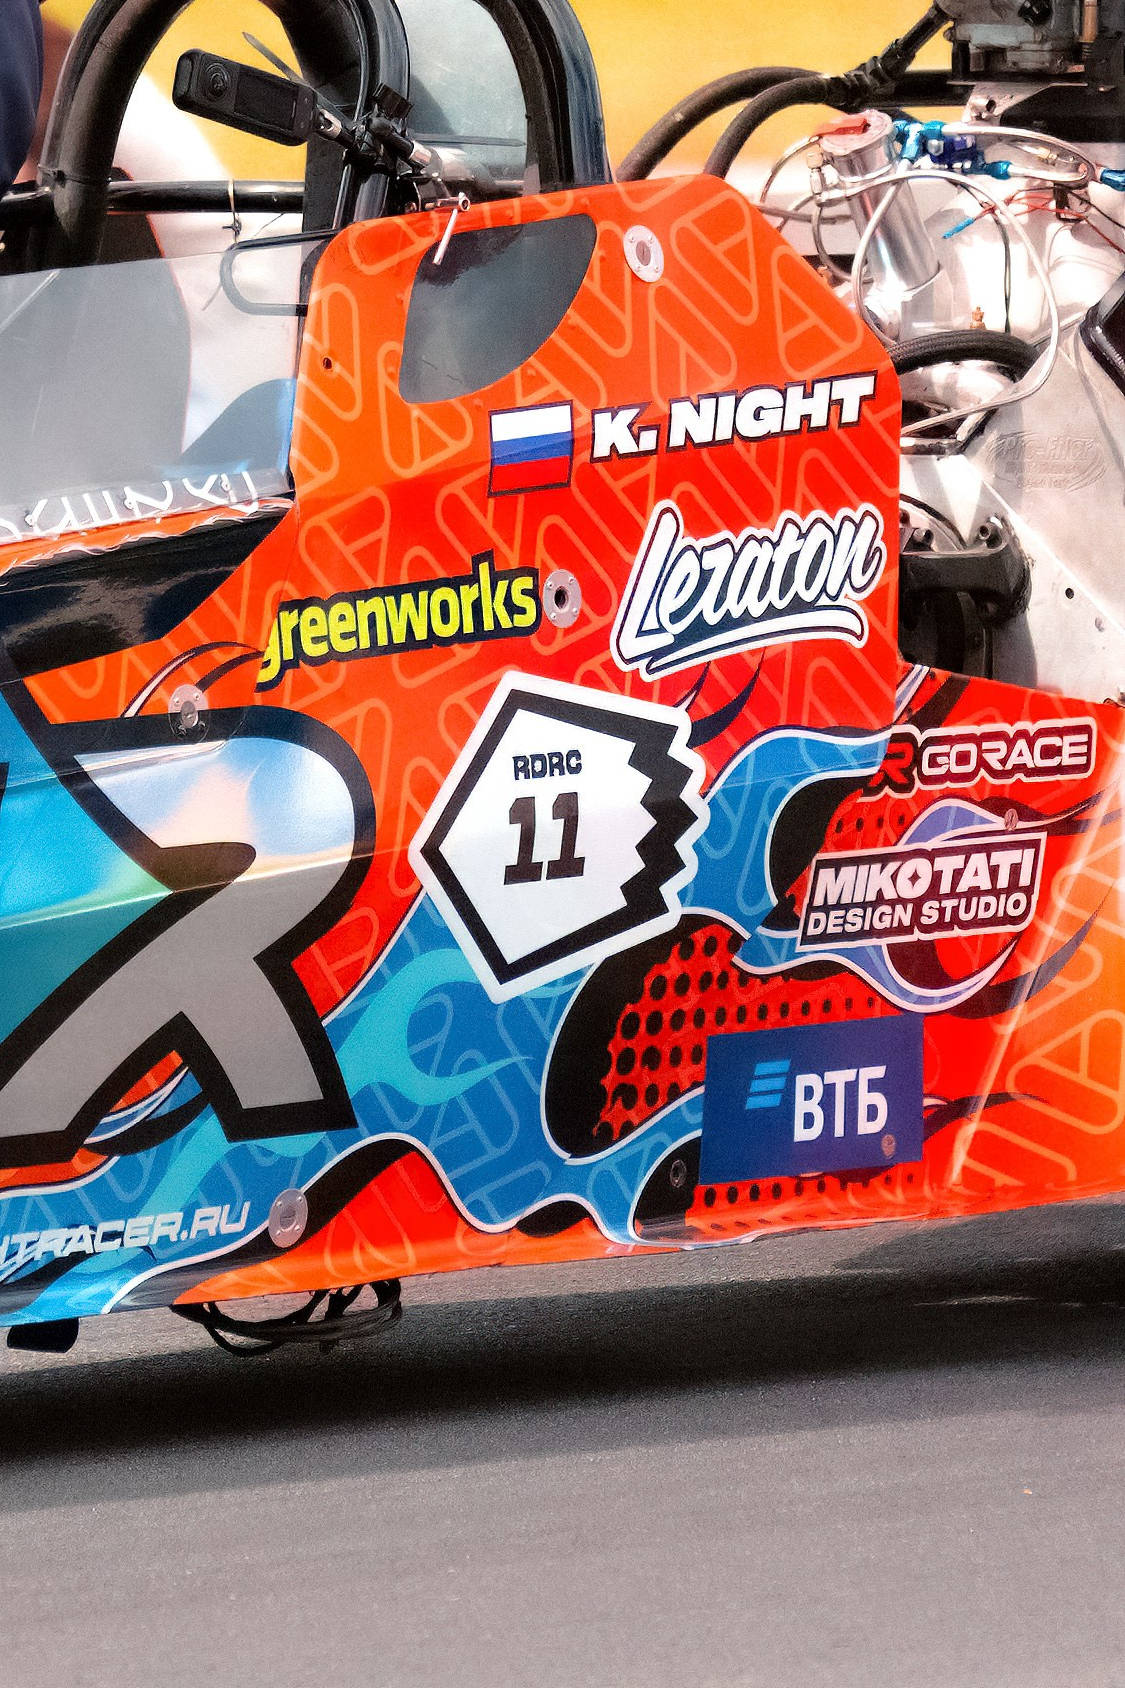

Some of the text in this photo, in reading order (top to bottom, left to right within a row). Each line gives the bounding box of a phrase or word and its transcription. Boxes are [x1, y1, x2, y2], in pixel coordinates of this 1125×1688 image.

[592, 370, 875, 459] K. NIGHT
[512, 748, 582, 781] RDRC
[502, 791, 587, 886] 11
[814, 848, 1036, 903] MIKOTATI
[806, 891, 1028, 937] DESIGN STUDIO
[792, 1064, 889, 1143] ВТБ
